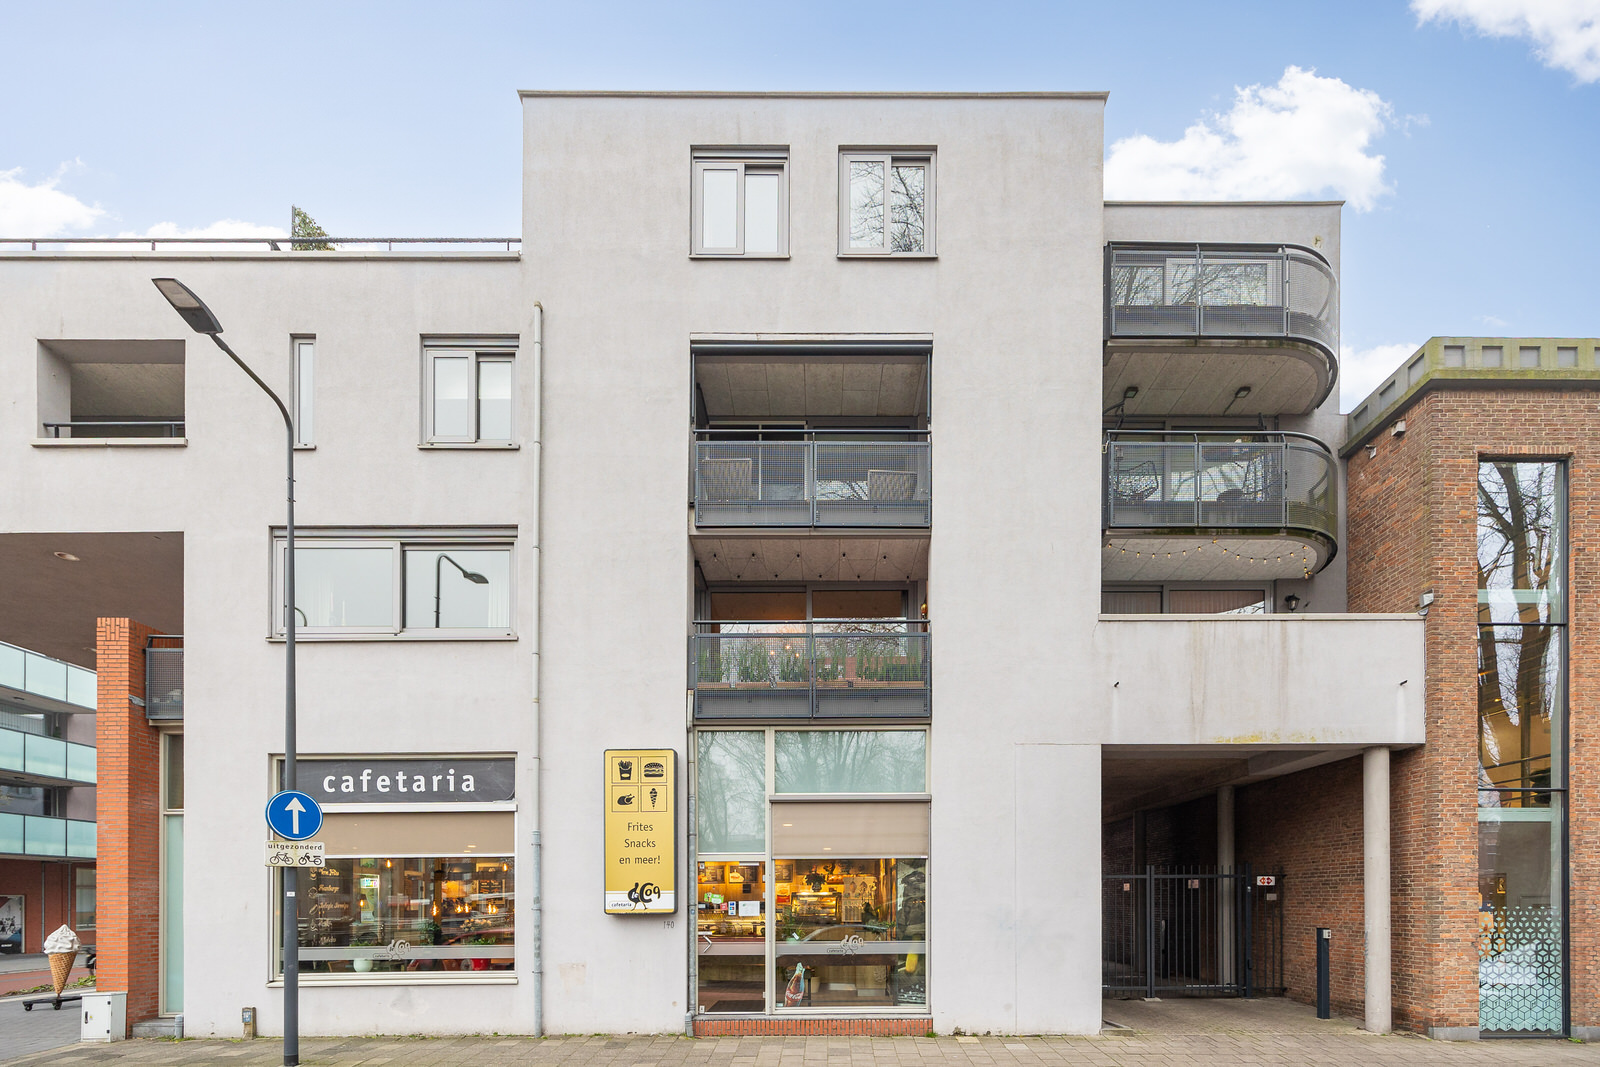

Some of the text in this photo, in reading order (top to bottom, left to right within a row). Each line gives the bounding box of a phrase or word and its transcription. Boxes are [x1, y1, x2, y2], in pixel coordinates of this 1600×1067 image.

[323, 768, 476, 793] cafetaria
[627, 822, 654, 832] Frites
[267, 842, 323, 851] uitgezonderd
[624, 838, 657, 848] Snacks
[619, 855, 661, 865] en meer!
[639, 882, 661, 904] Coq
